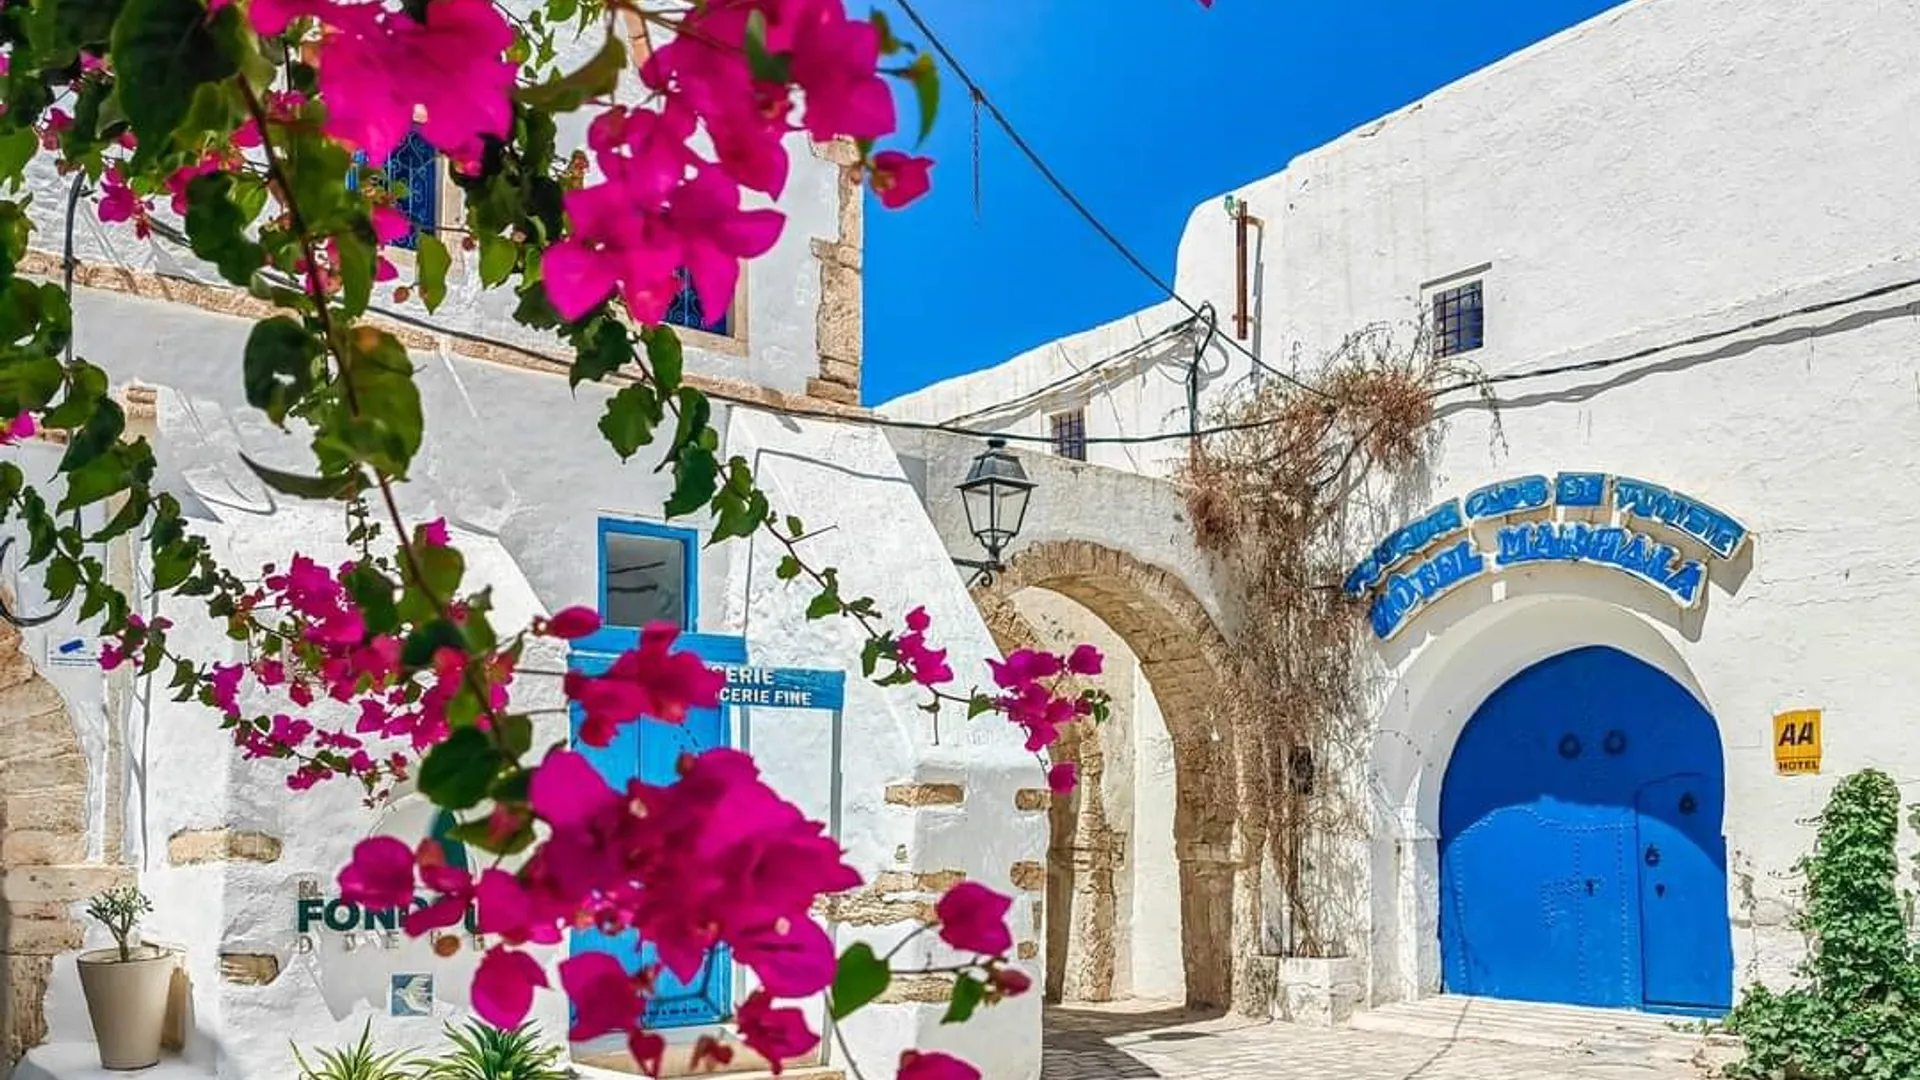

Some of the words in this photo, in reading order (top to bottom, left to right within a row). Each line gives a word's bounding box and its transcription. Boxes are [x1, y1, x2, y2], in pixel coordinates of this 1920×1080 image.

[773, 688, 812, 706] FINE
[1778, 722, 1814, 746] AA
[1778, 760, 1819, 772] HOTEL
